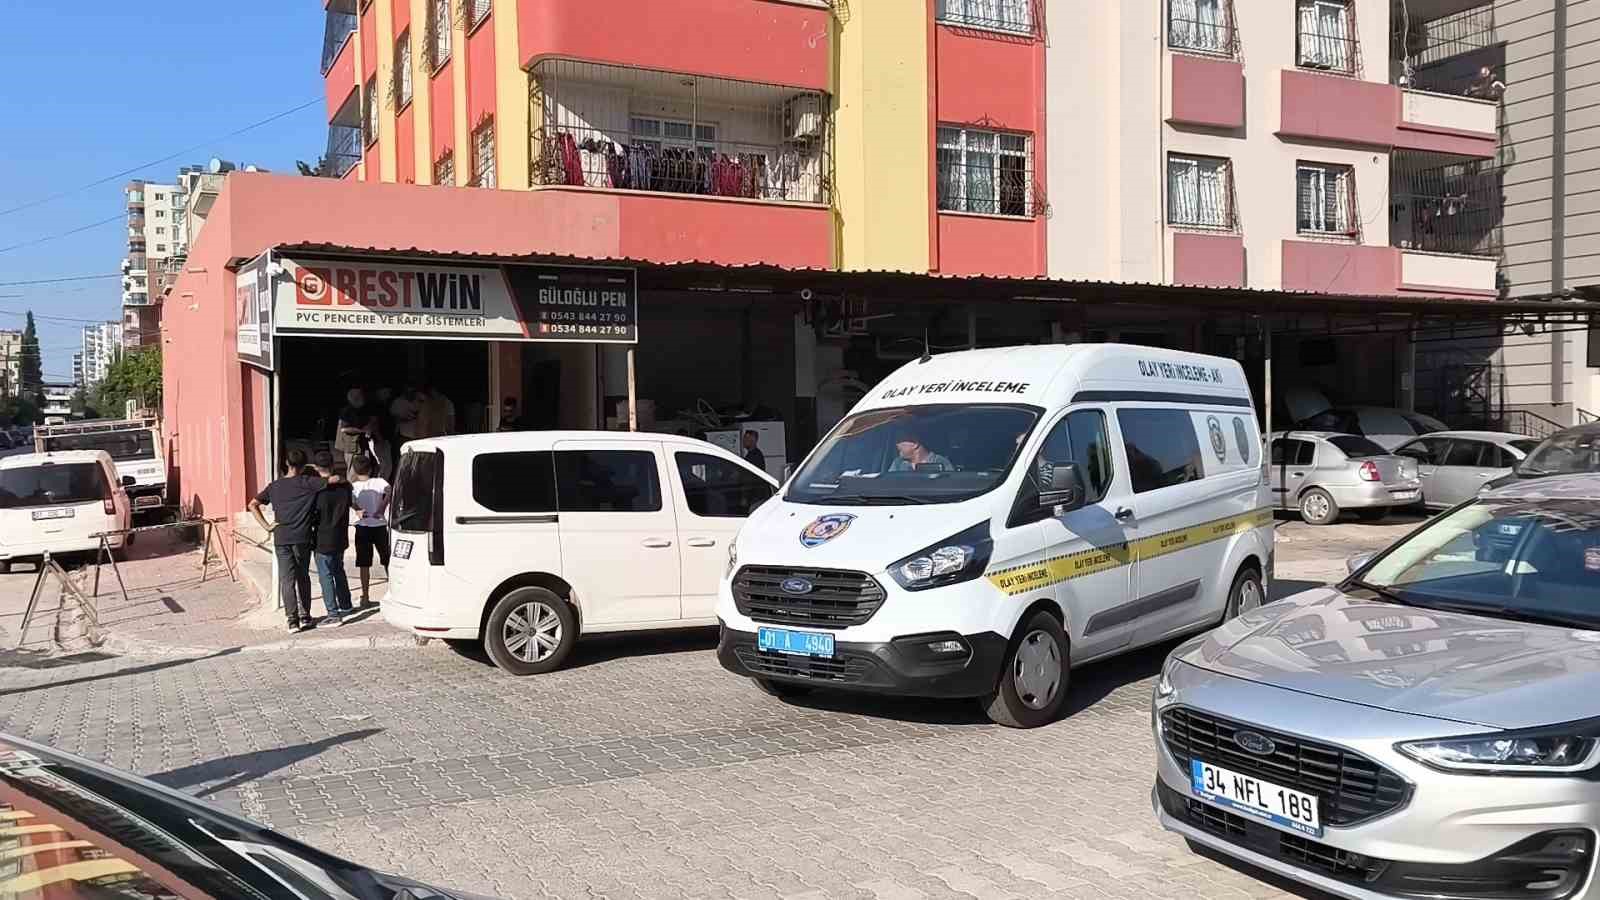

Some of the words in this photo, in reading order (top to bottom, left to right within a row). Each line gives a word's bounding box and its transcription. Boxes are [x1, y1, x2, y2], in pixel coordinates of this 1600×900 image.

[539, 285, 598, 306] GÜLOĞLU
[601, 291, 627, 307] PEN
[296, 313, 319, 323] PVC
[324, 313, 376, 324] PENCERE
[380, 316, 394, 325] VE
[397, 316, 422, 326] KAPI
[551, 311, 576, 321] 0543
[600, 313, 611, 322] 27
[614, 313, 626, 322] 90
[551, 324, 576, 334] 0534
[578, 325, 597, 334] 844
[600, 326, 612, 335] 27
[614, 326, 627, 335] 90
[881, 385, 918, 399] OLAY
[918, 380, 953, 394] YERİ
[951, 379, 1031, 394] İNCELEME
[765, 630, 776, 646] 01
[784, 633, 792, 649] A
[804, 635, 832, 652] 4940
[1204, 766, 1226, 795] 34
[1233, 775, 1268, 809] NFL
[1278, 789, 1313, 822] 189
